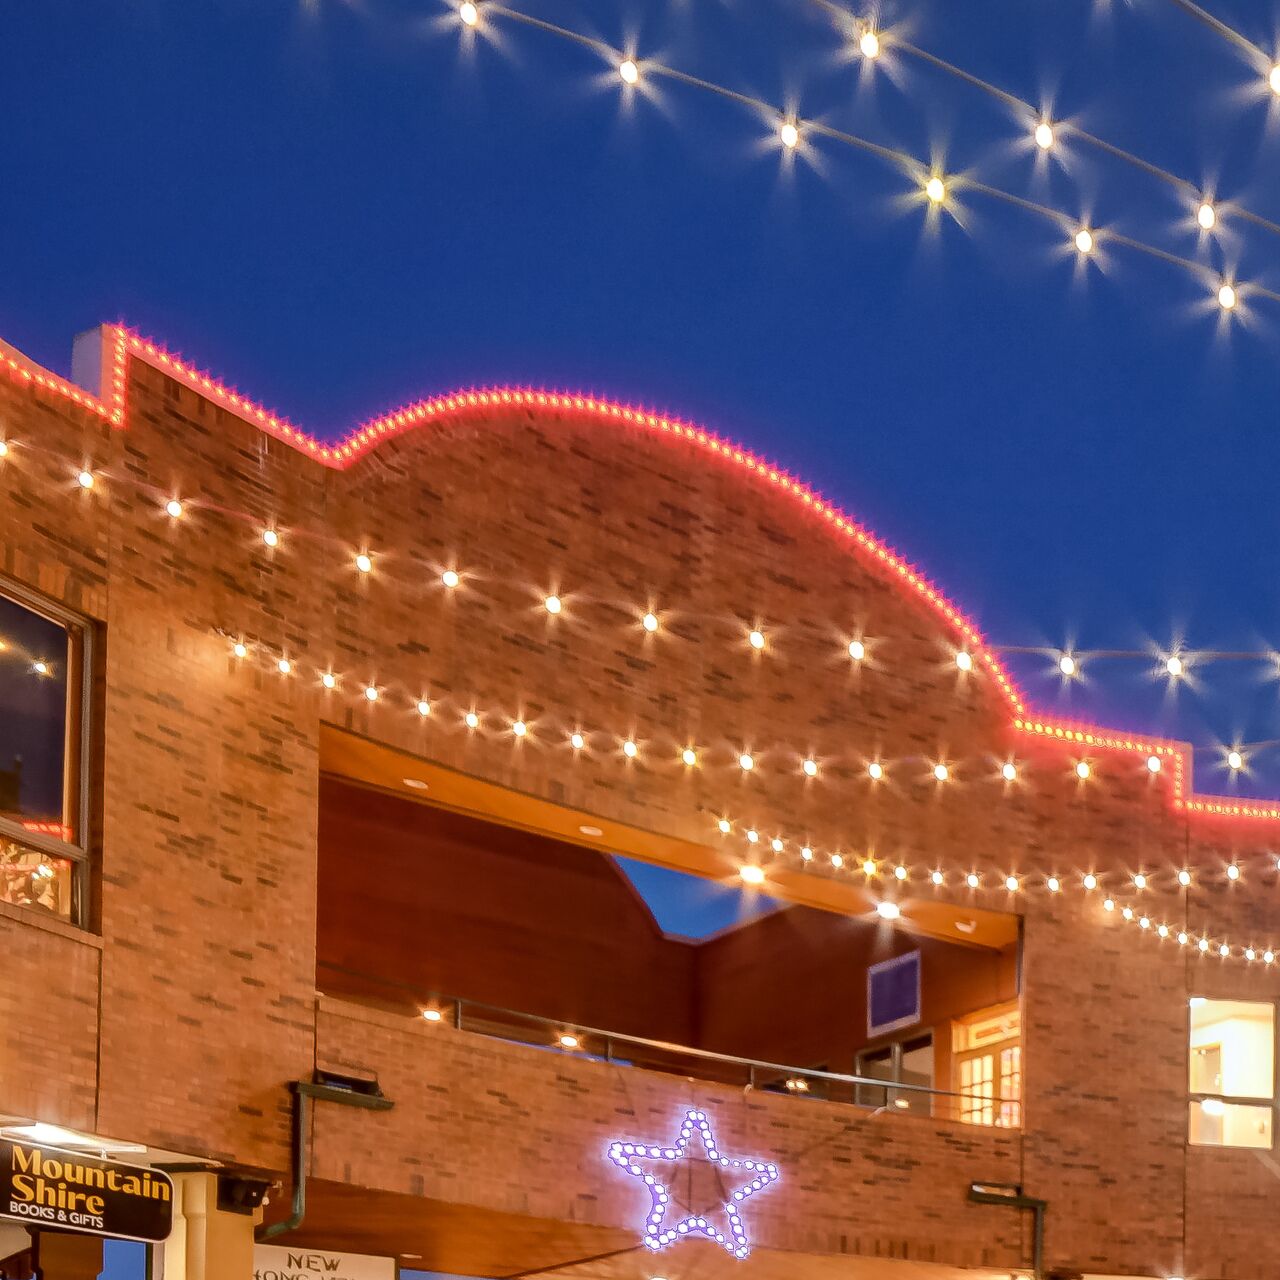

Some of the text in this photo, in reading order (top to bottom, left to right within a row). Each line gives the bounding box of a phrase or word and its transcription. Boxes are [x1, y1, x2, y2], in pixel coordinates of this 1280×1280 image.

[11, 1144, 170, 1201] Mountain
[11, 1174, 105, 1216] Shire
[9, 1200, 104, 1228] BOOKS & GIFTS
[287, 1252, 341, 1273] NEW
